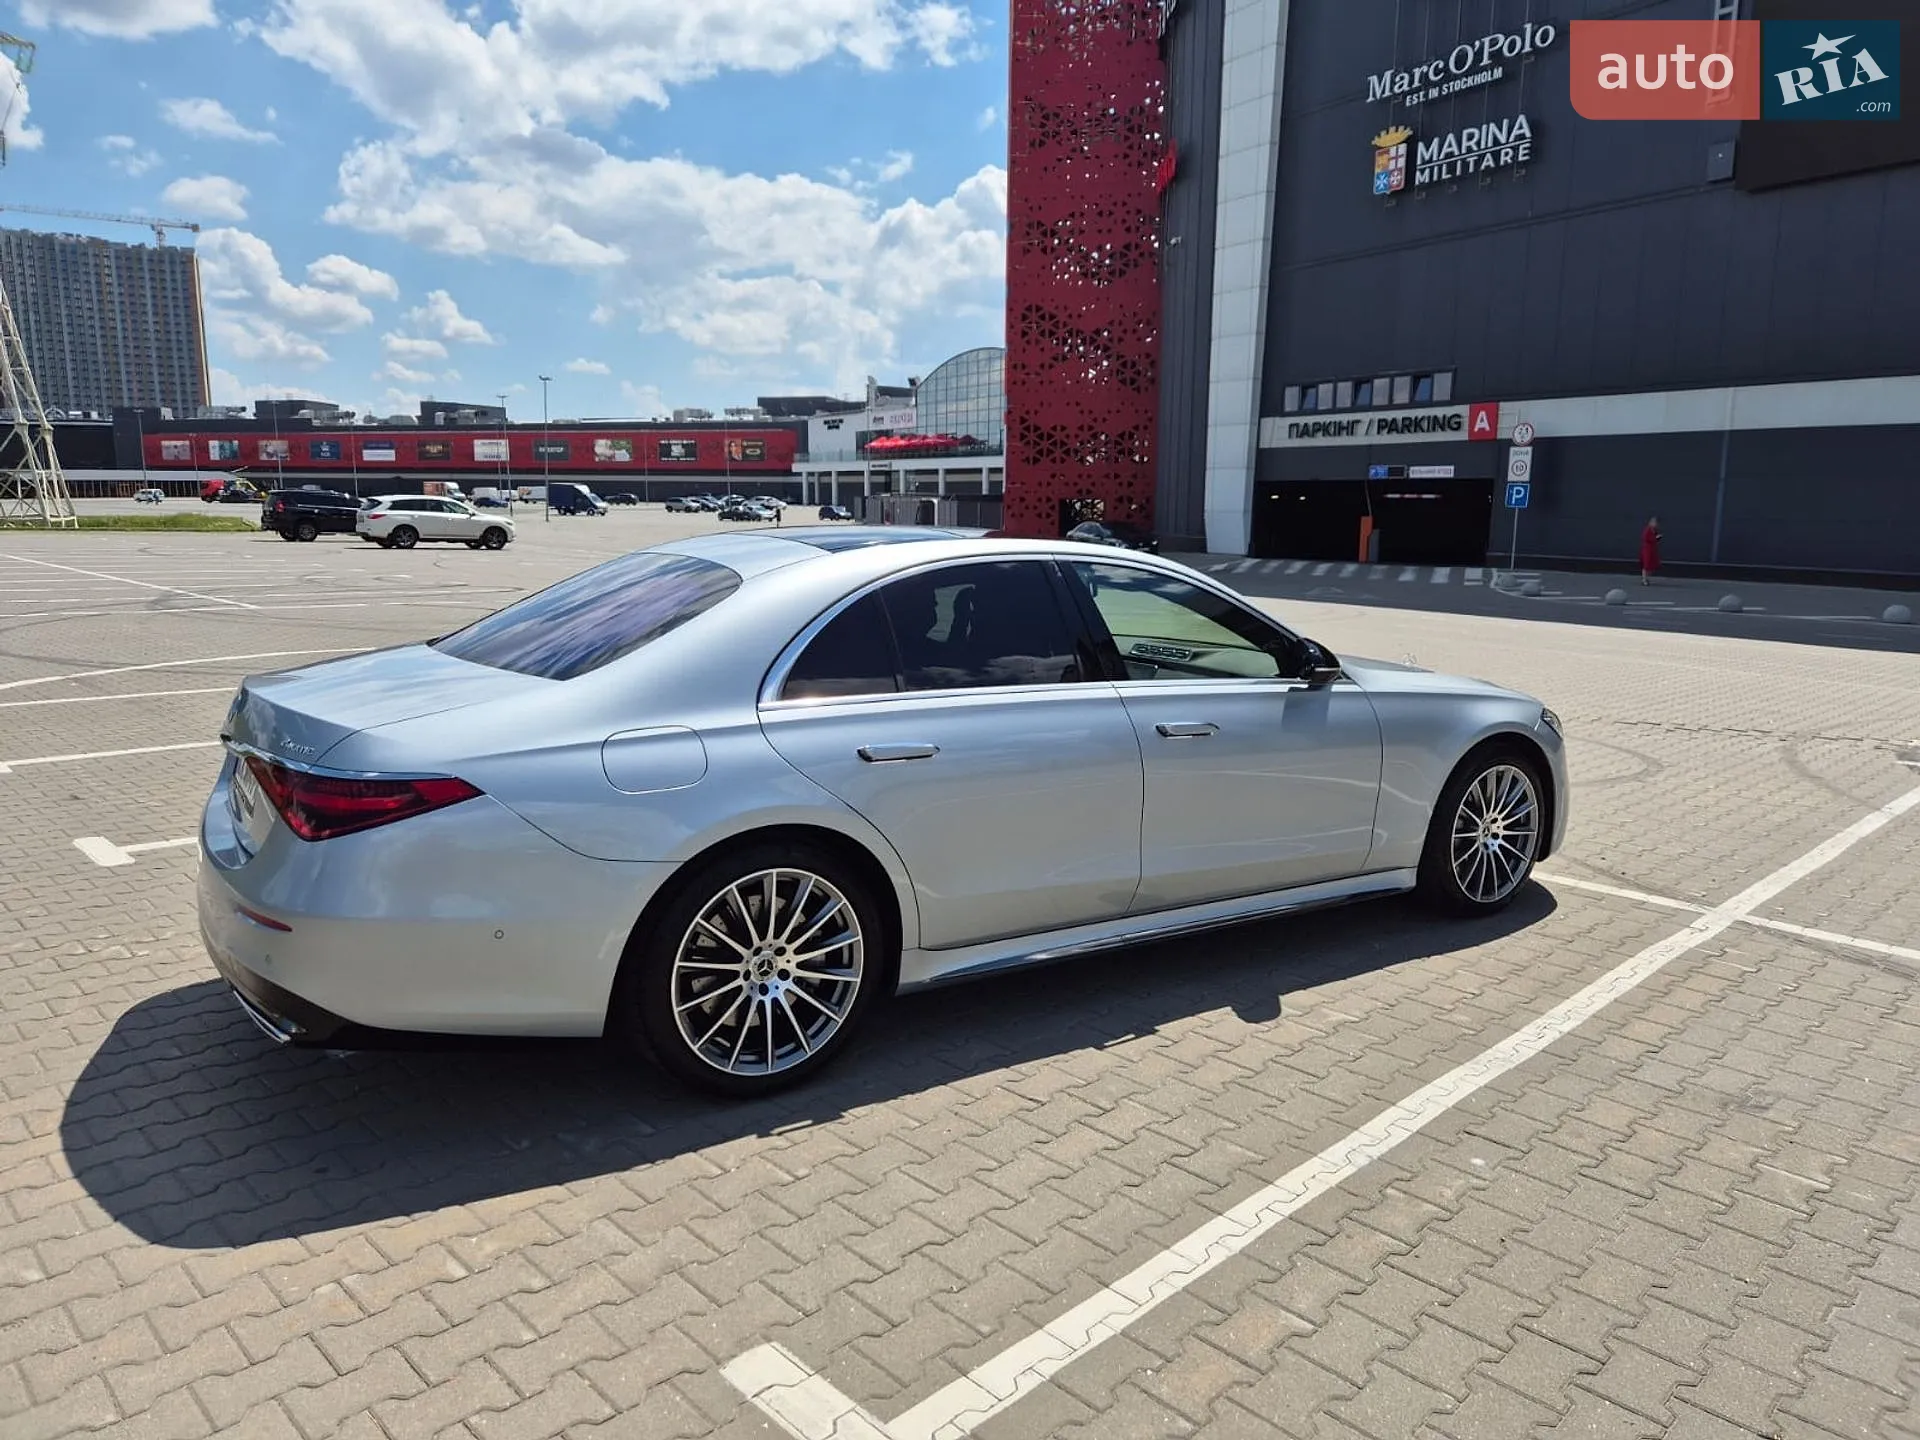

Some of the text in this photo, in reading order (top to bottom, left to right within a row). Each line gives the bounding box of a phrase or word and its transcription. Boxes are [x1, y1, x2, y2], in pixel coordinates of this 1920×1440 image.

[1366, 22, 1556, 103] Marc O'Polo
[1428, 87, 1440, 100] IN
[1441, 66, 1503, 96] STOCKHOLM
[1416, 114, 1533, 166] MARINA
[1415, 143, 1532, 185] MILITARE
[1287, 419, 1362, 440] ПАРКІНГ
[1376, 413, 1463, 435] PARKING
[1511, 486, 1525, 505] P
